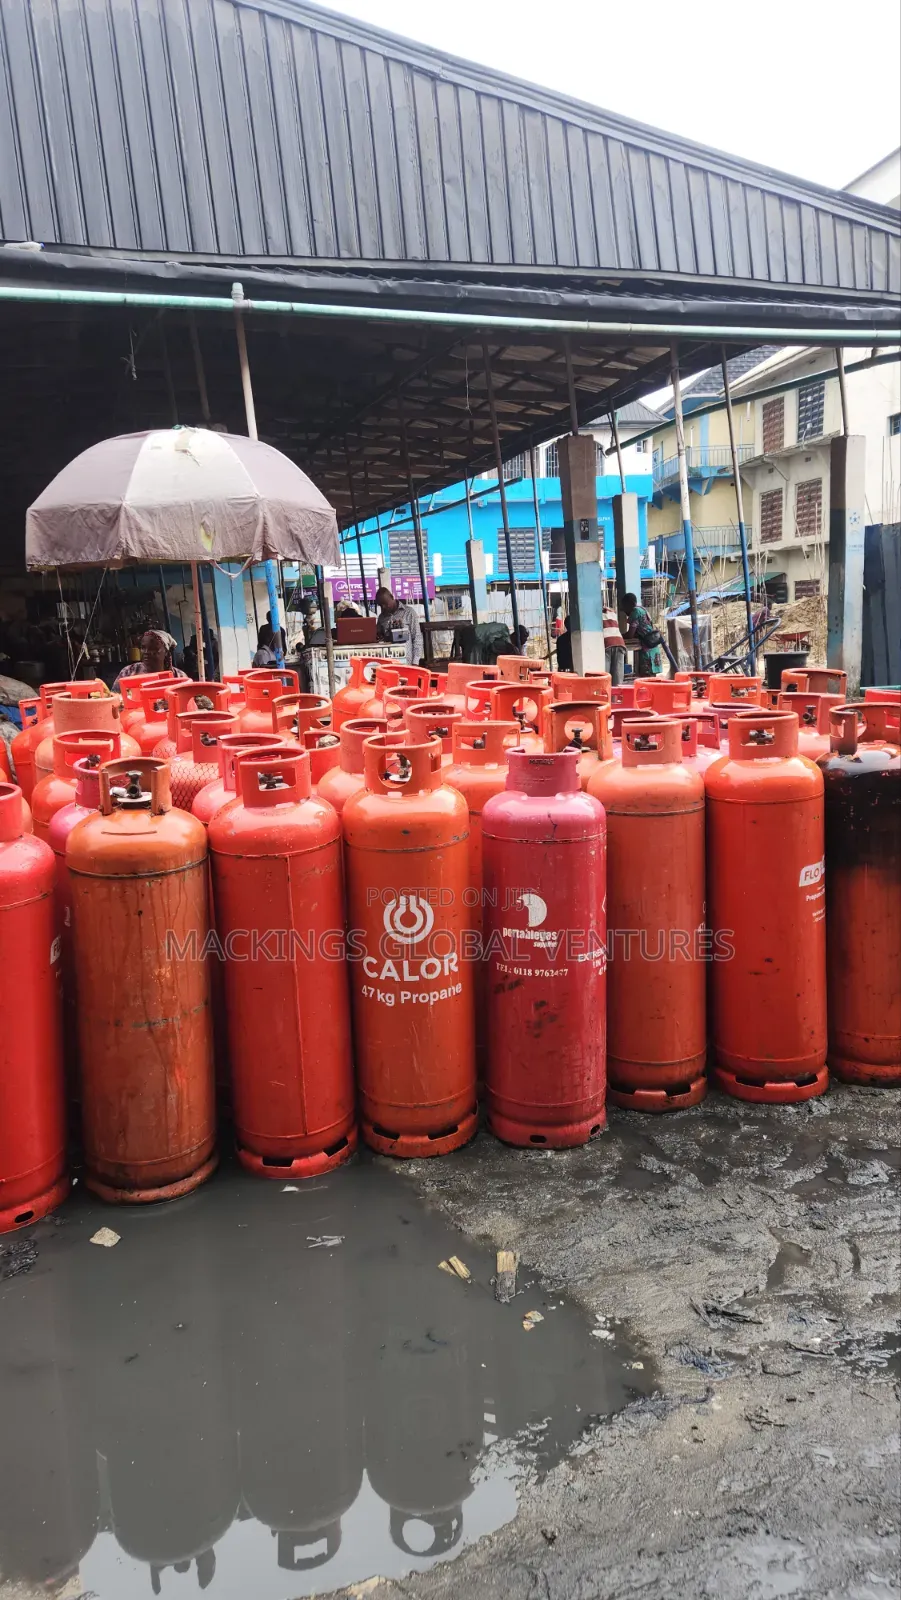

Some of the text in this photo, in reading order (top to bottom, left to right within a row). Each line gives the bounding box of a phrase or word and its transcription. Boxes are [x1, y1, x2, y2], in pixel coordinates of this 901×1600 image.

[363, 952, 459, 981] CALOR
[513, 967, 533, 976] 0118
[401, 982, 462, 1005] Propane
